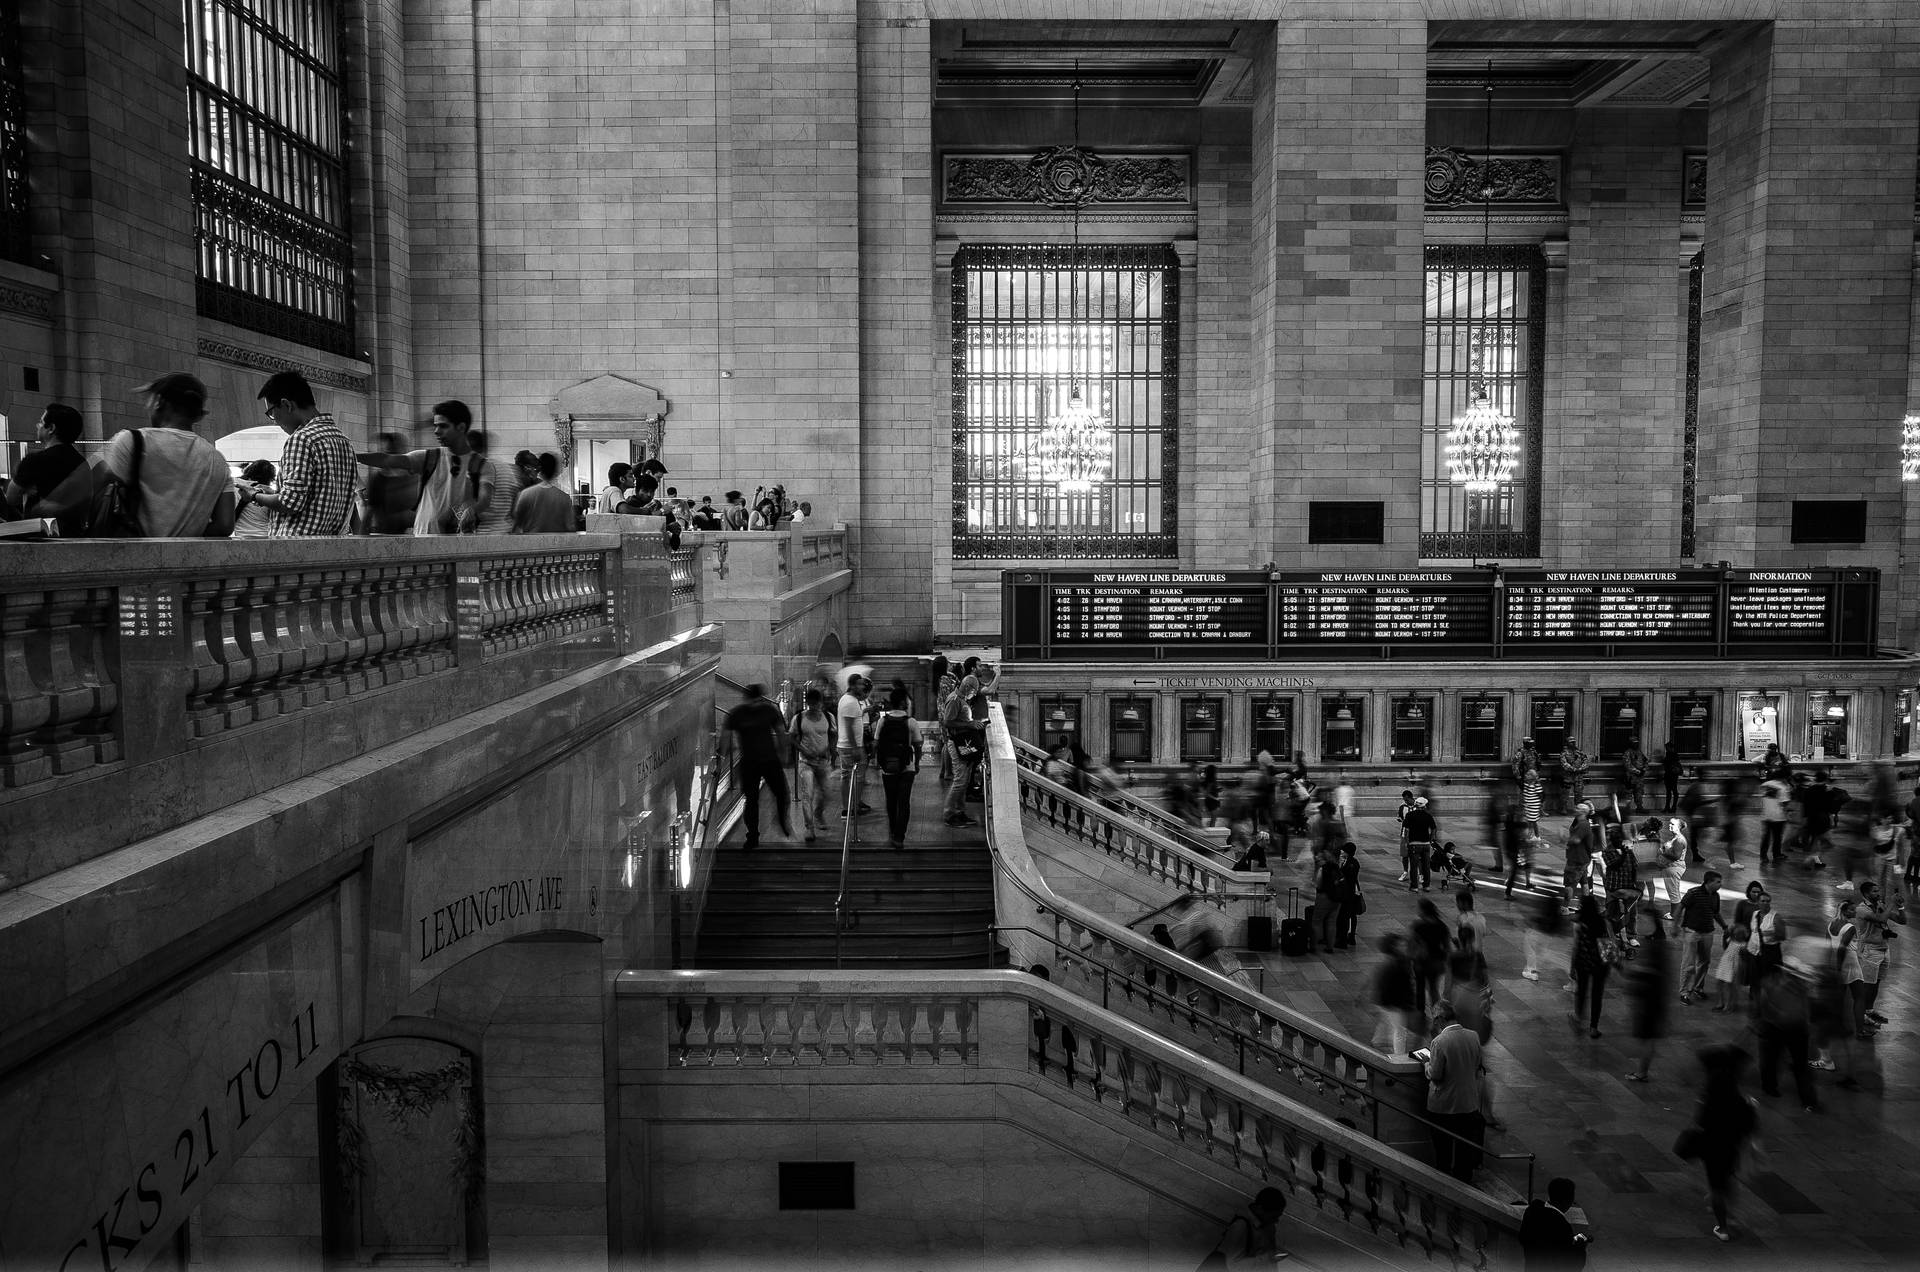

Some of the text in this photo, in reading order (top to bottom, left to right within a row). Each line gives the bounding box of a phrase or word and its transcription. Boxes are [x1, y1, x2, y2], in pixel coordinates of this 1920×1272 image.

[1094, 574, 1226, 582] NEW HAVEN LINE DEPARTURES
[1321, 574, 1452, 582] NEW HAVEN LINE DEPARTURES
[1546, 573, 1677, 581] NEW HAVEN LINE DEPARTURES
[1159, 677, 1314, 688] TICKET VENDING MACHINES
[637, 736, 679, 784] EAST BALCONY
[419, 876, 562, 962] LEXINGTON AVE
[174, 1106, 218, 1196] 21
[226, 1039, 282, 1130] TO
[291, 1002, 320, 1069] 11
